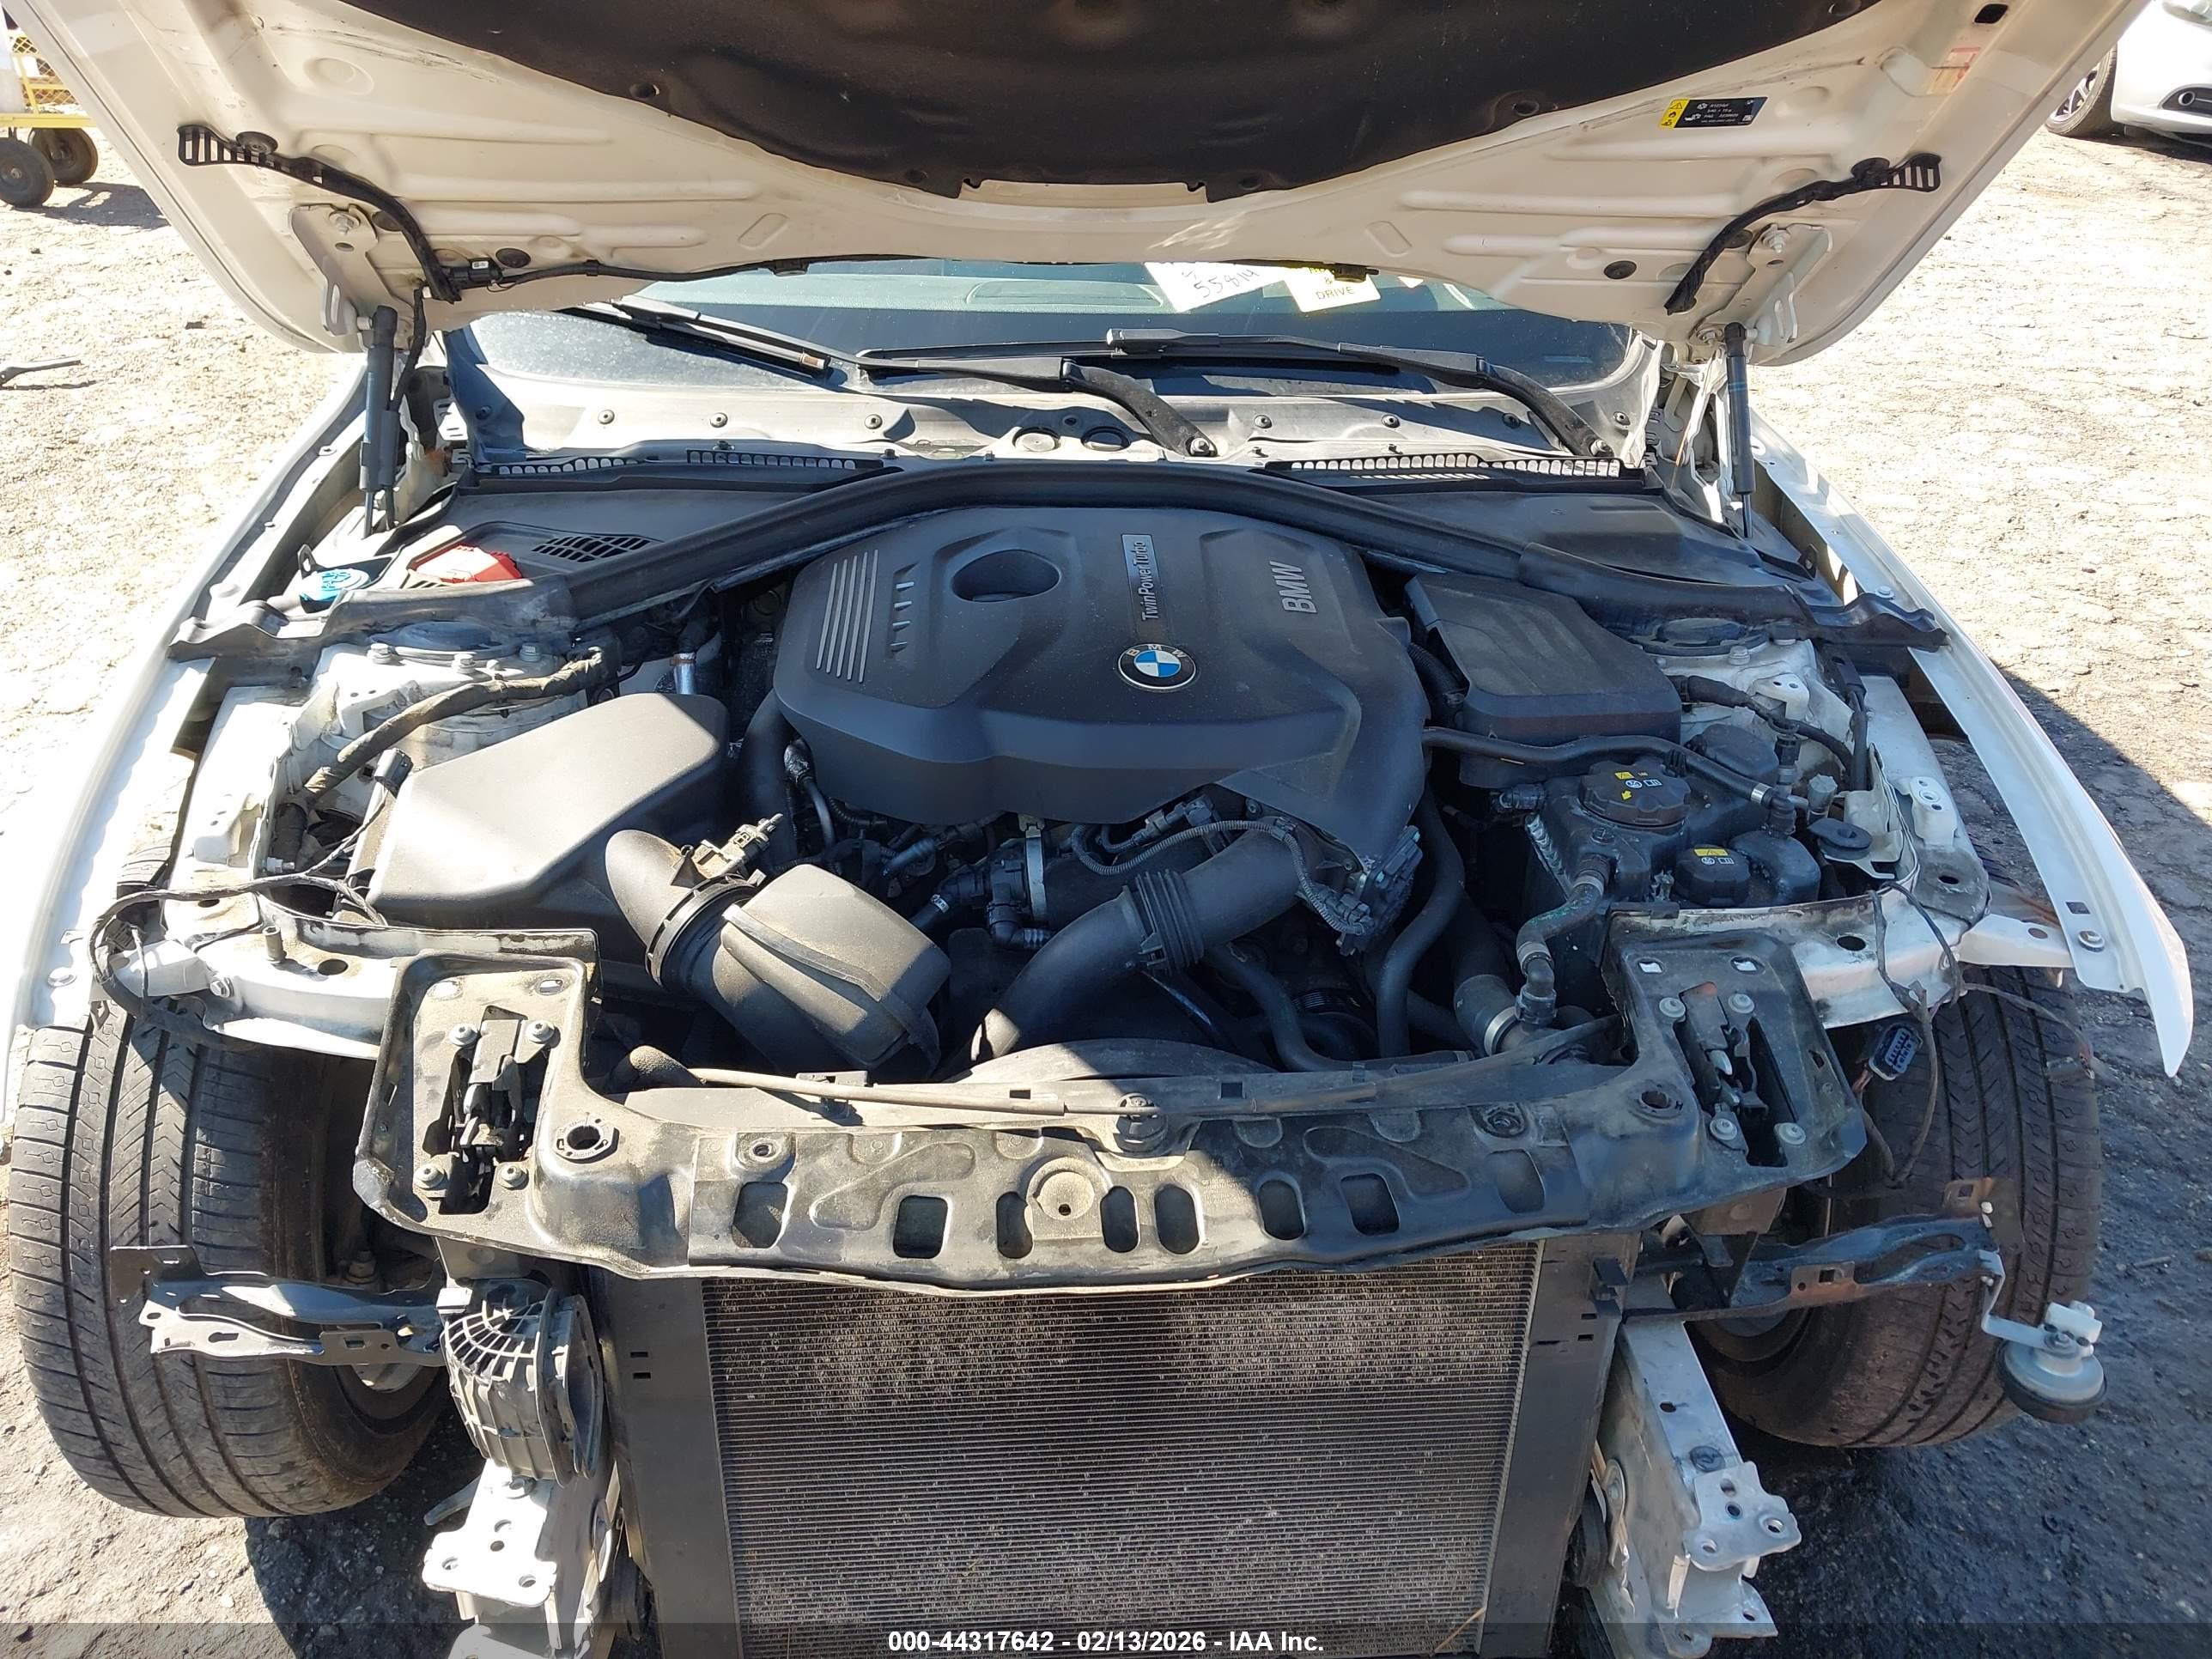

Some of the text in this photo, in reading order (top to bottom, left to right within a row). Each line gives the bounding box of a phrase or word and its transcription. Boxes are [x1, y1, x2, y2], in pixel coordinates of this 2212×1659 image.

[1315, 286, 1355, 300] DRIVE
[1132, 541, 1159, 621] TwinPower Turbo
[1269, 560, 1319, 614] BMW
[1126, 644, 1188, 659] BMW
